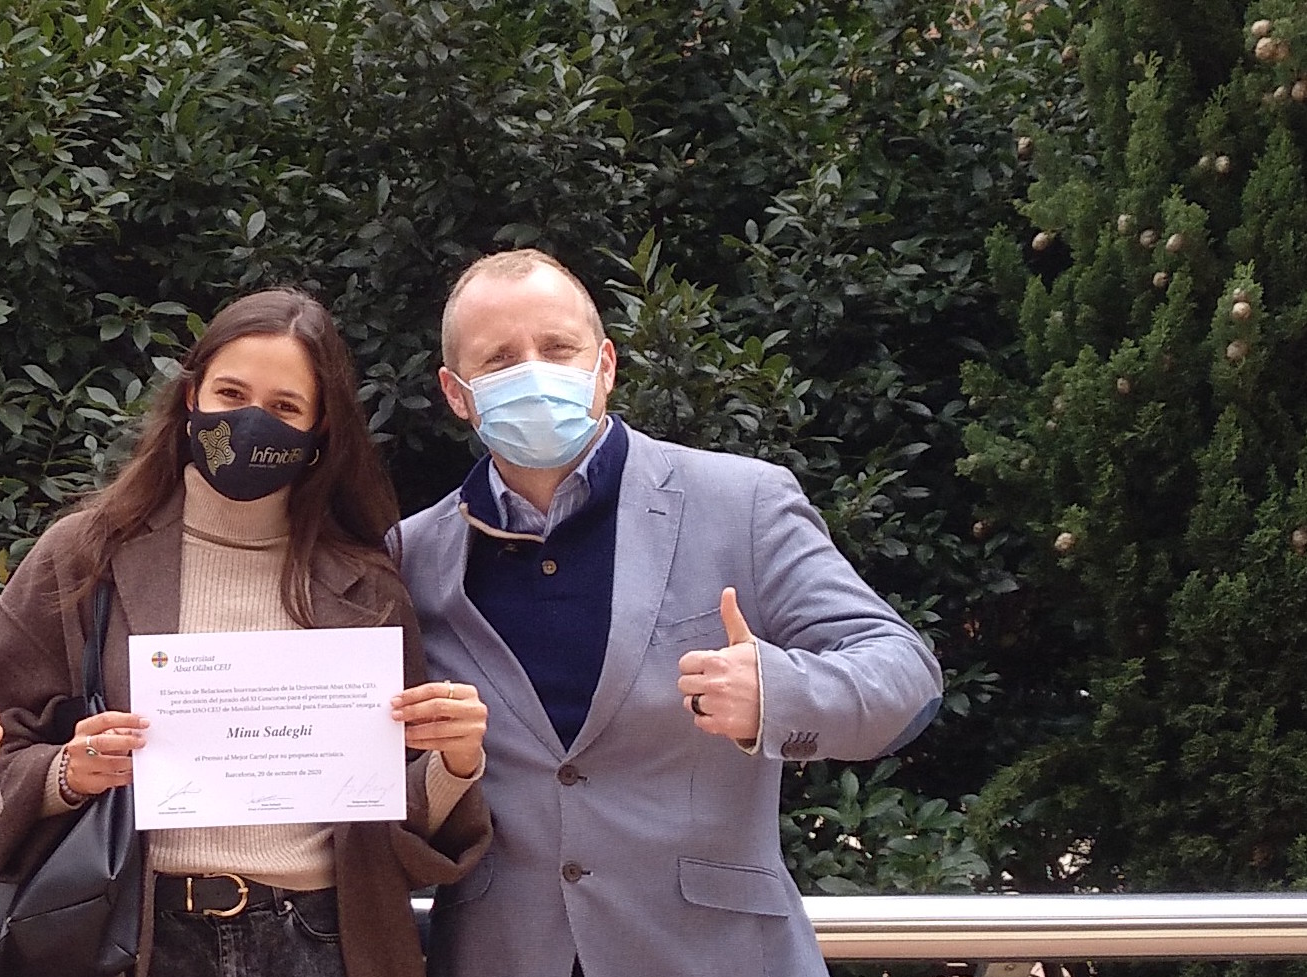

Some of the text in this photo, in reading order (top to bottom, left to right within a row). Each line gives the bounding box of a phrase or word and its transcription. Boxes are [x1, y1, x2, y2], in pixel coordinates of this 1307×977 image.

[174, 655, 215, 663] Universitat
[214, 663, 231, 671] CEU
[287, 695, 301, 703] para
[226, 724, 313, 740] Minu Sadeghi
[230, 754, 248, 762] Mejor
[268, 753, 279, 761] por
